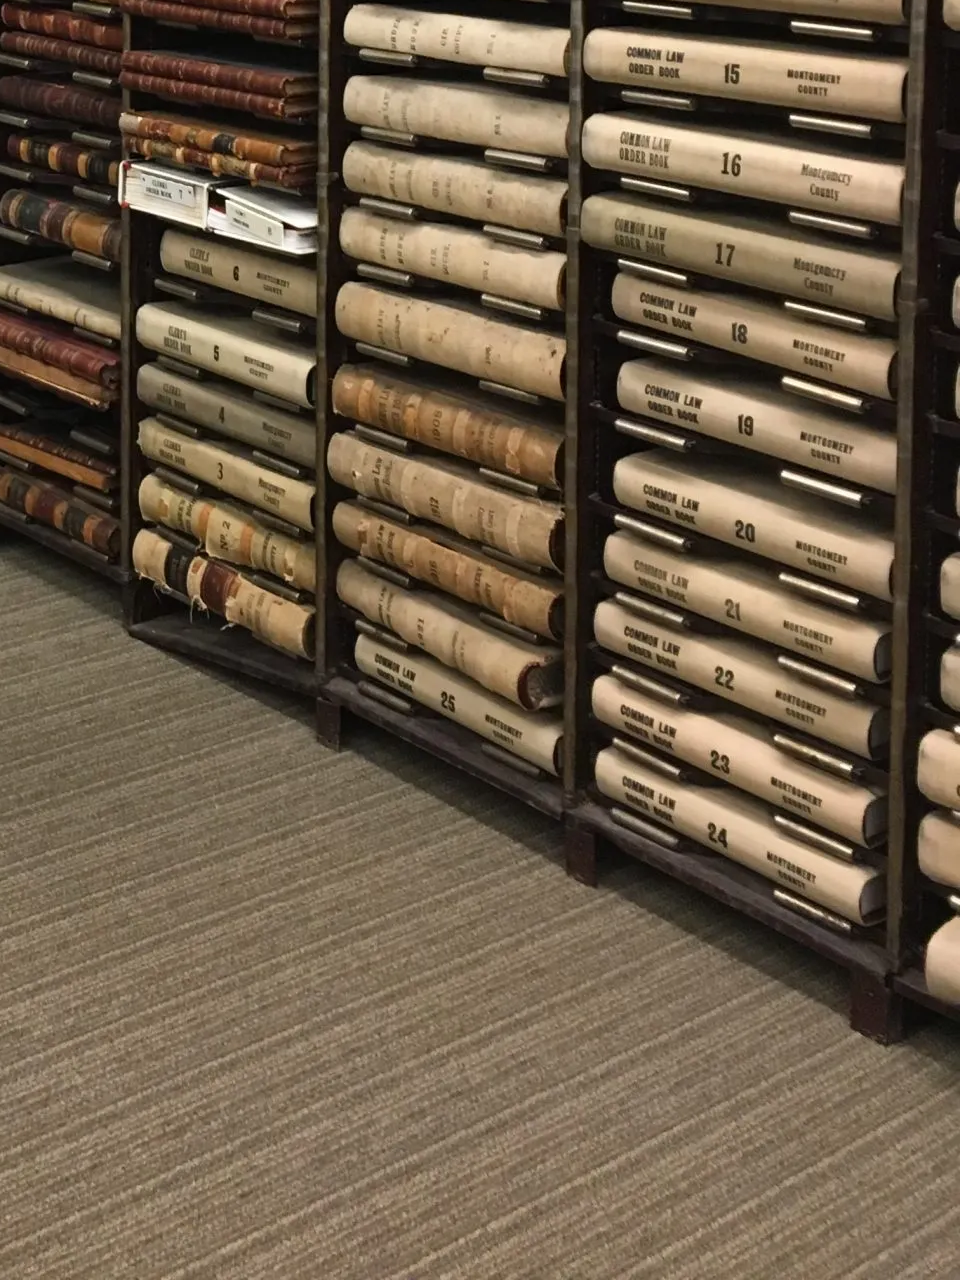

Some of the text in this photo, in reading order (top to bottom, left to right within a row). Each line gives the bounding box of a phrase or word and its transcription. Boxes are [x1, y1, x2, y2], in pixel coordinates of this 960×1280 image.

[626, 46, 684, 63] COMMON LAW
[629, 64, 680, 79] ORDER BOOK
[724, 64, 740, 85] 15
[787, 69, 841, 85] MONTGOMERY
[620, 131, 672, 152] COMMON LAW
[619, 148, 670, 169] ORDER BOOK
[720, 152, 741, 175] 16
[614, 218, 667, 240] COMMON LAW
[614, 234, 667, 257] ORDER BOOK
[715, 242, 736, 265] 17
[233, 266, 239, 281] 6
[640, 292, 697, 317] COMMON LAW
[732, 322, 748, 344] 18
[214, 345, 219, 361] 5
[793, 339, 846, 362] MONTGOMERY
[644, 384, 703, 409] COMMON LAW
[218, 406, 225, 424] 4
[738, 415, 754, 436] 19
[800, 431, 854, 455] MONTGOMERY
[217, 463, 223, 479] 3
[643, 484, 699, 512] COMMON LAW
[735, 520, 755, 542] 20
[796, 541, 848, 565] MONTGOMERY
[634, 560, 689, 589] COMMON LAW
[724, 599, 740, 621] 21
[623, 626, 680, 656] COMMON LAW
[783, 620, 833, 646] MONTGOMERY
[374, 653, 417, 681] COMMON LAW
[715, 666, 735, 691] 22
[440, 692, 456, 712] 25
[775, 689, 827, 717] MONTGOMERY
[484, 713, 523, 741] MONTGOMERY
[620, 704, 677, 739] COMMON LAW
[710, 751, 730, 774] 23
[622, 776, 676, 809] COMMON LAW
[770, 776, 822, 808] MONTGOMERY
[707, 823, 728, 848] 24
[766, 851, 817, 884] MONTGOMERY
